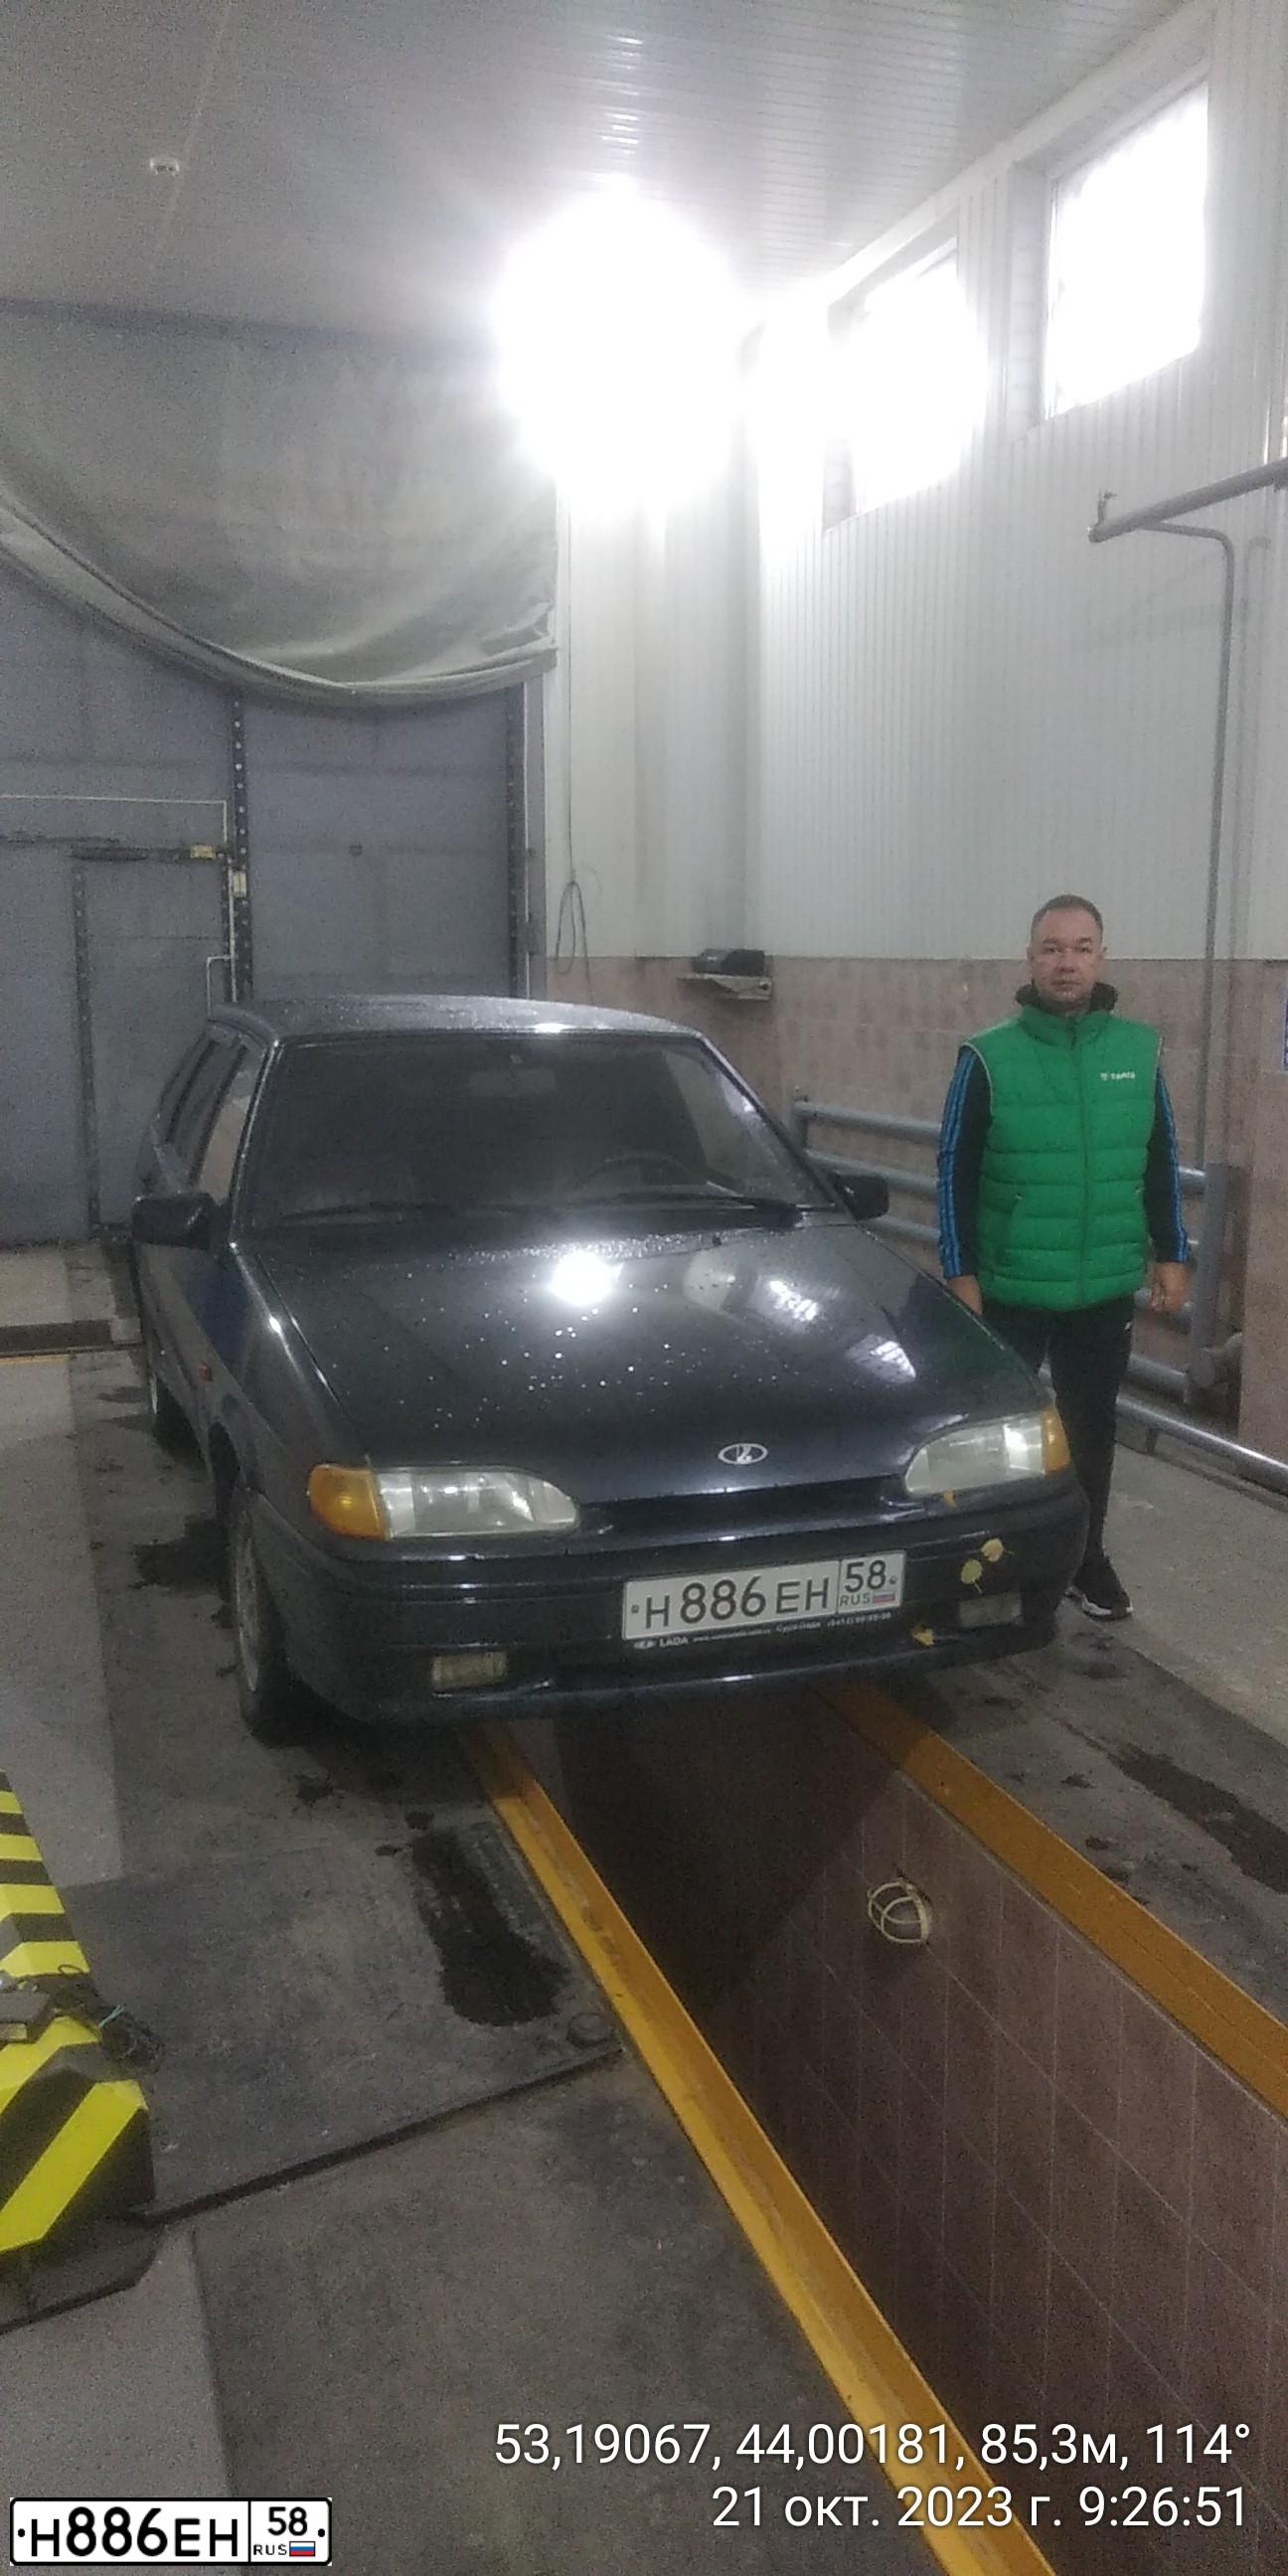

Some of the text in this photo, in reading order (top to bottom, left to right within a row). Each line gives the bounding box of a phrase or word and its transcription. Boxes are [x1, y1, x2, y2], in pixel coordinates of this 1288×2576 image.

[844, 1559, 887, 1593] 58
[839, 1592, 872, 1608] RUS
[659, 1636, 689, 1649] LADA
